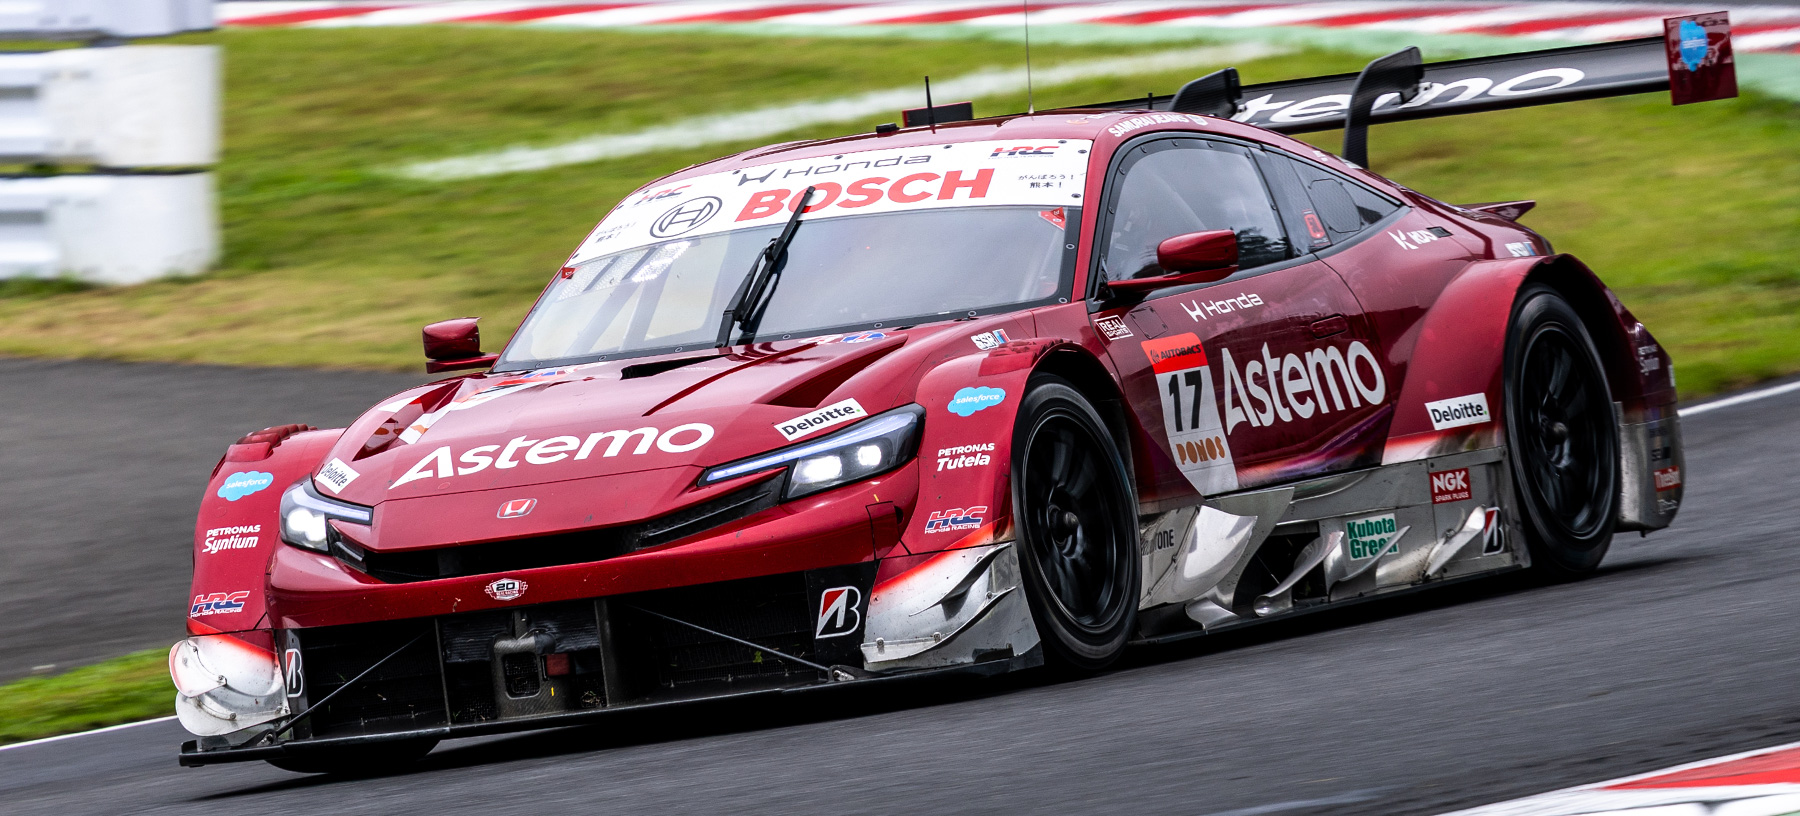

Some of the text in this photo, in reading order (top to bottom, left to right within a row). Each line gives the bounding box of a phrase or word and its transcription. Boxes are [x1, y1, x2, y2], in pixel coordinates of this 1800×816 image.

[1108, 114, 1154, 138] SAMURAI
[1151, 113, 1190, 126] JEANS
[990, 145, 1060, 158] HRC
[783, 154, 932, 179] Honda
[734, 168, 995, 222] BOSCH
[1201, 292, 1265, 317] Honda
[1100, 318, 1126, 332] REAL
[1107, 326, 1131, 338] SPORTS
[1160, 343, 1202, 360] AUTOBACS
[1220, 340, 1387, 436] Astemo
[955, 392, 1000, 406] salesforce
[1168, 369, 1203, 433] 17
[388, 422, 715, 490] Astemo
[937, 443, 995, 457] PETRONAS
[1175, 435, 1226, 466] PONOS
[936, 453, 991, 472] Tutela
[226, 478, 268, 490] salesforce
[1432, 470, 1468, 494] NGK
[1435, 491, 1469, 503] SPARK PLUGS
[925, 506, 988, 530] HRC
[206, 525, 261, 538] PETRONAS
[1346, 518, 1396, 540] Kubota
[202, 535, 259, 554] Syntium
[495, 581, 515, 592] 20
[190, 590, 250, 615] HRC
[214, 608, 242, 616] RACING
